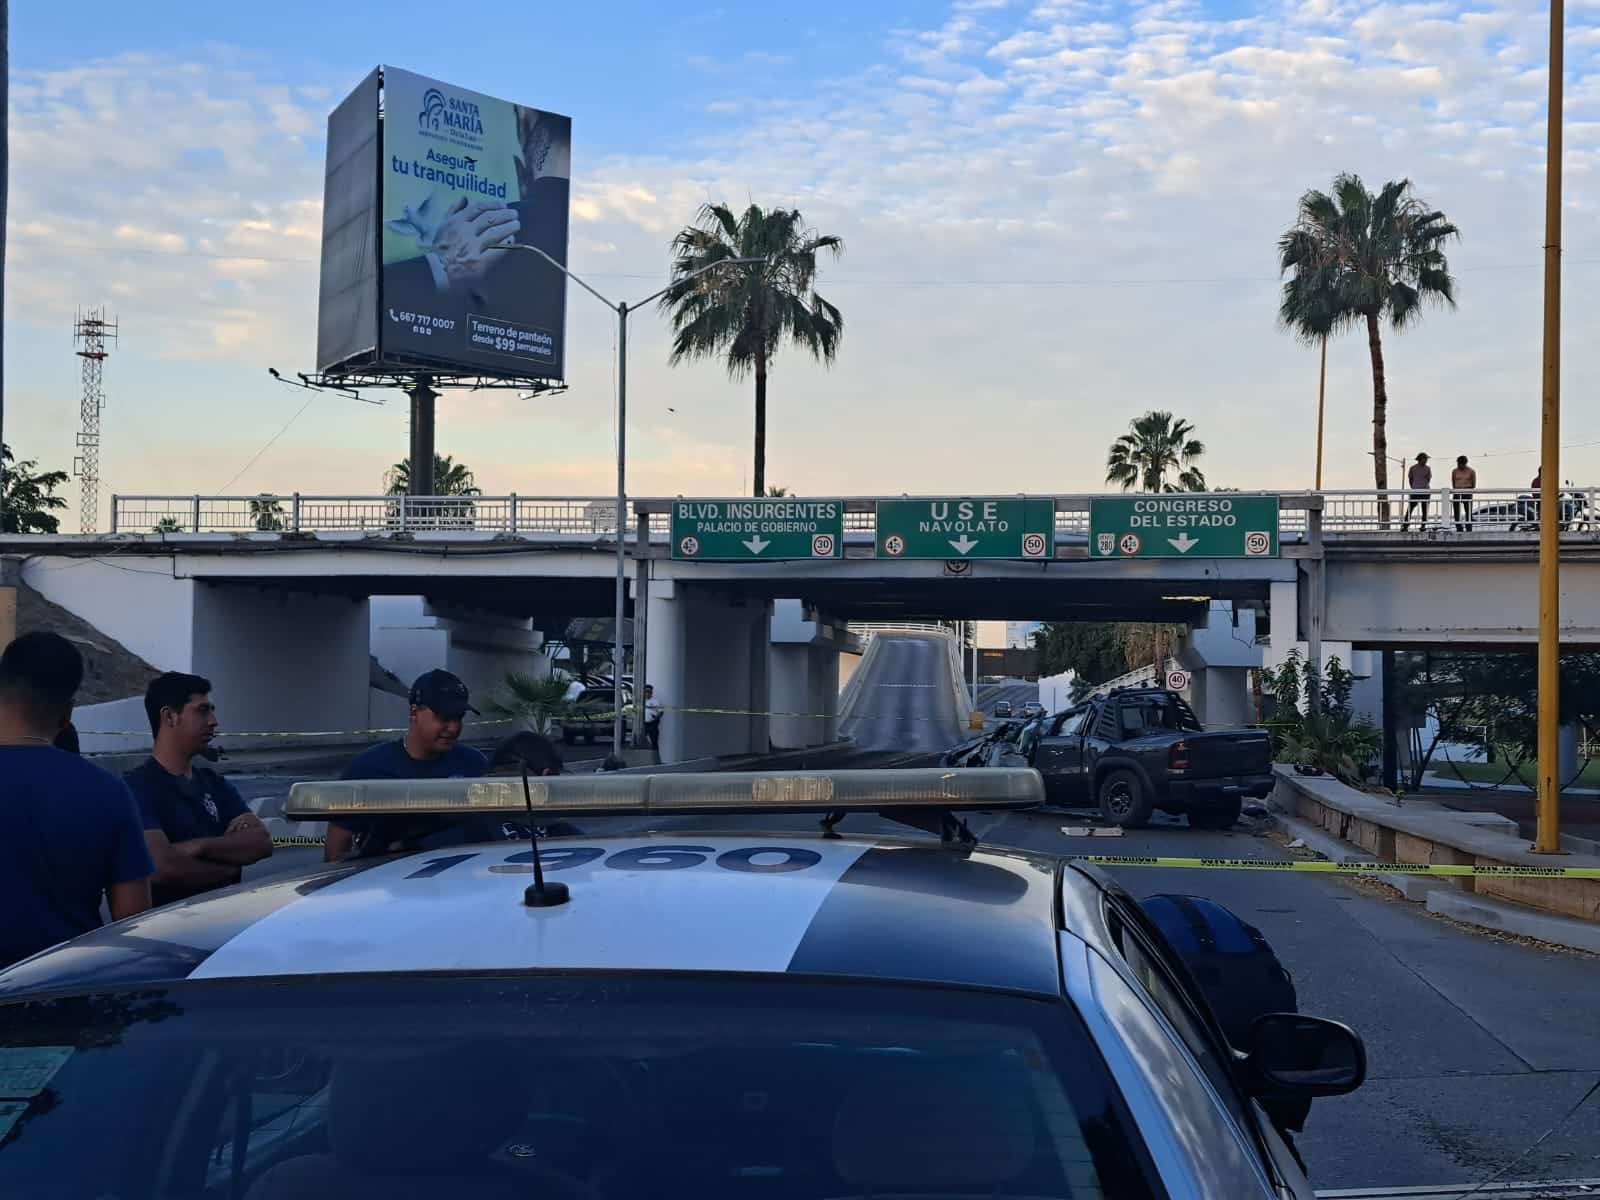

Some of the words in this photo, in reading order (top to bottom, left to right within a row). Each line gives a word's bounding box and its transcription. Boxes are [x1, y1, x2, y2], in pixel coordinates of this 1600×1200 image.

[449, 97, 480, 117] SANTA
[426, 148, 475, 172] Asegura
[392, 155, 409, 174] tu
[413, 160, 506, 199] tranquilidad
[400, 311, 415, 323] 667
[417, 315, 431, 325] 717
[433, 317, 455, 330] 0007
[472, 320, 505, 336] Terreno
[507, 326, 517, 338] de
[518, 328, 552, 345] panteón
[472, 334, 494, 345] desde
[495, 337, 515, 351] $99
[679, 503, 723, 519] BLVD.
[727, 503, 836, 519] INSURGENTES
[1134, 499, 1232, 513] CONGRESO
[697, 522, 742, 533] PALACIO
[744, 522, 759, 533] DE
[761, 522, 817, 533] GOBIERNO
[919, 521, 1009, 532] NAVOLATO
[1130, 515, 1161, 527] DEL
[1166, 515, 1236, 527] ESTADO
[817, 540, 829, 548] 30
[1028, 539, 1040, 548] 50
[1100, 541, 1113, 551] 280
[1251, 537, 1264, 546] 50
[402, 846, 822, 879] 1960
